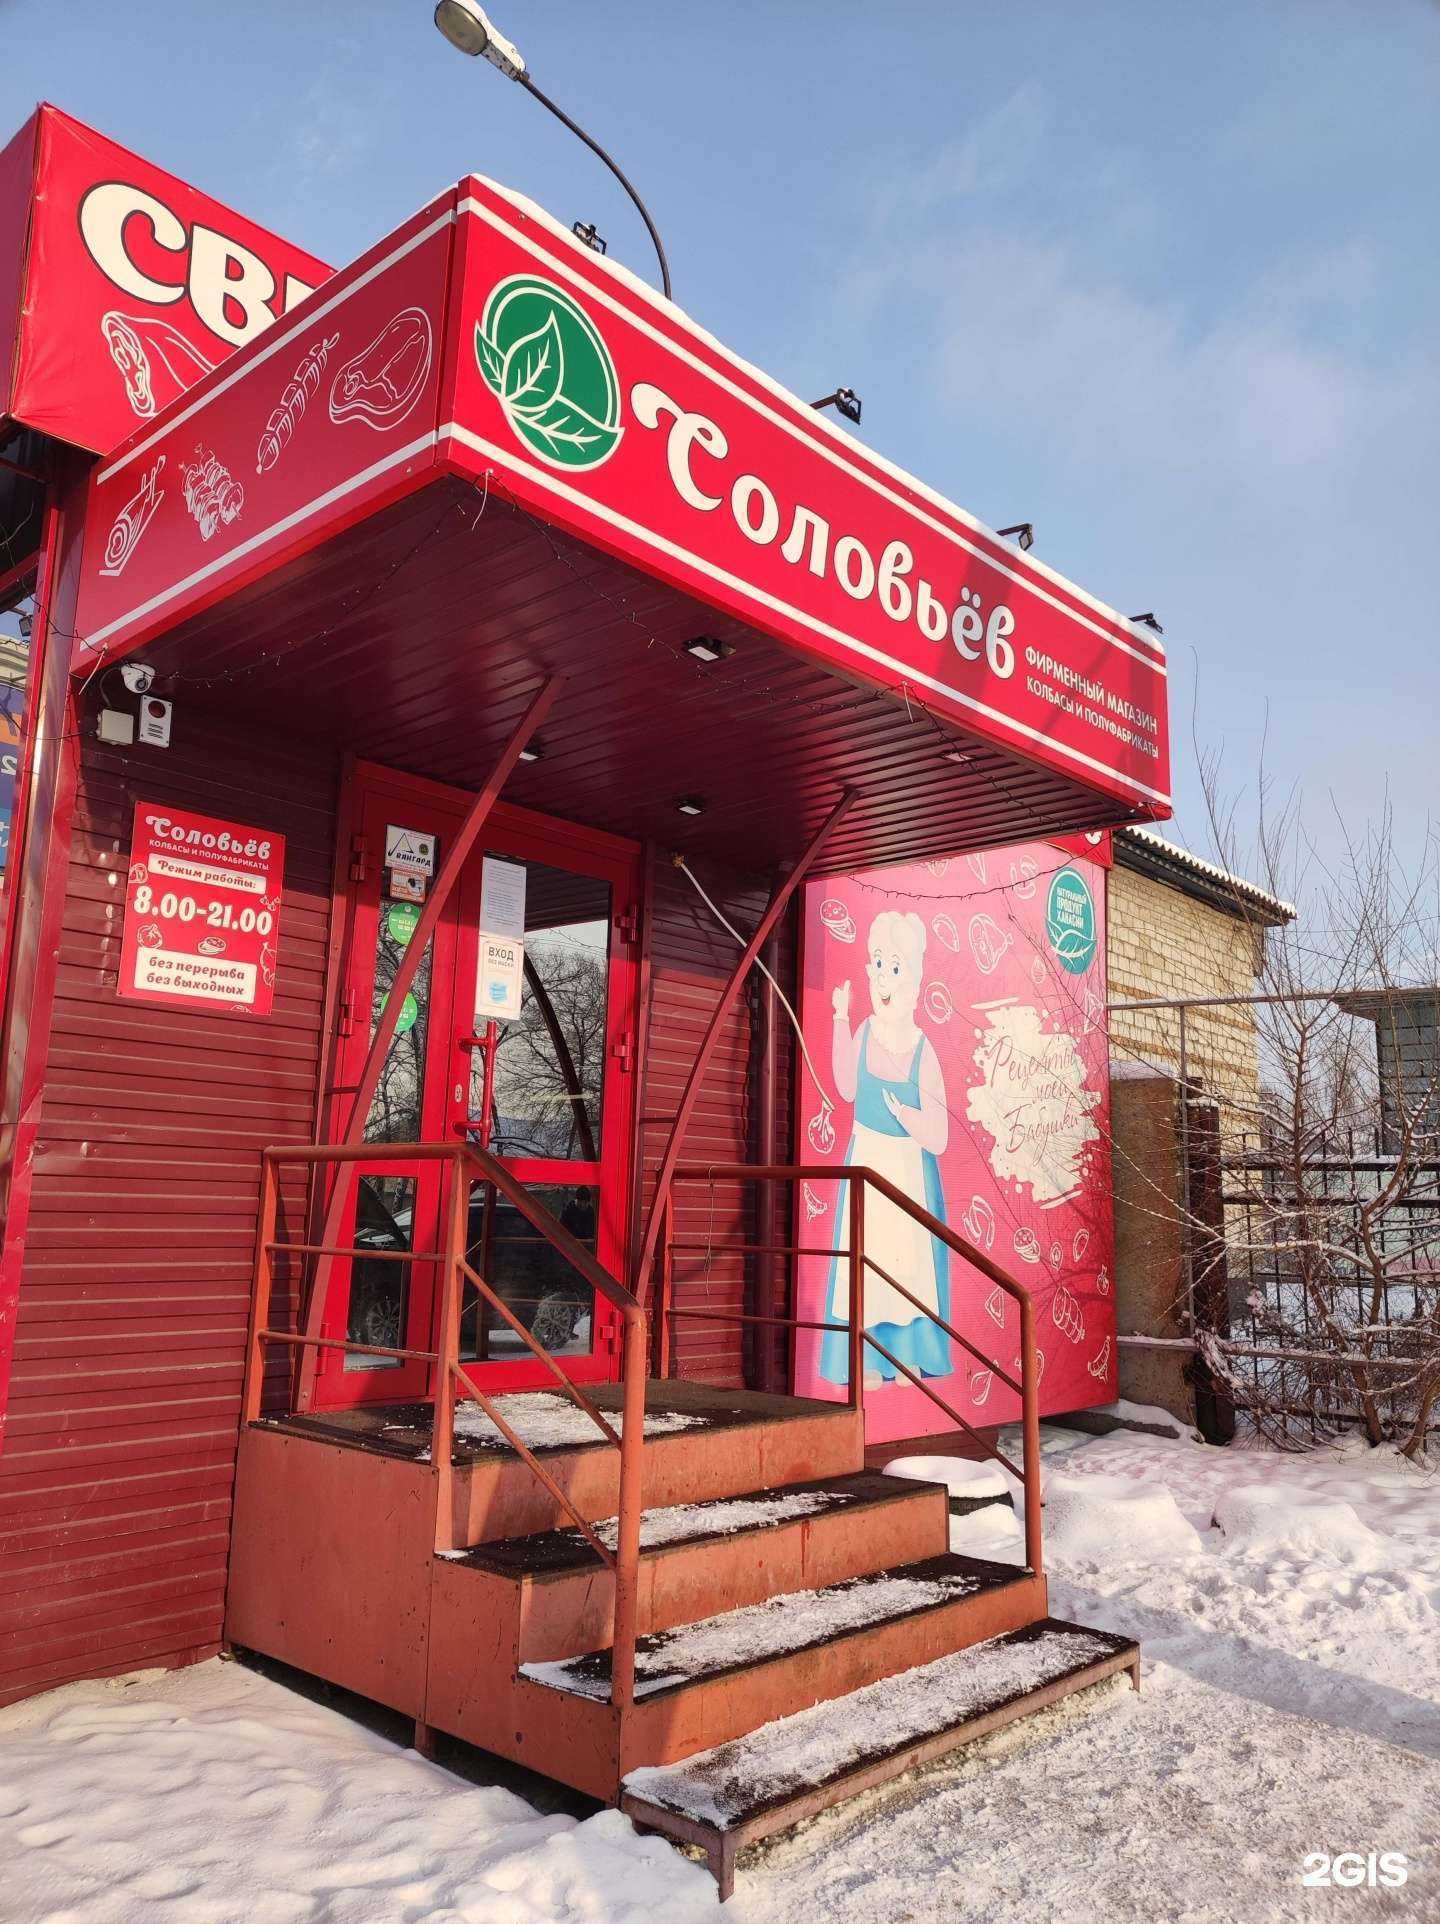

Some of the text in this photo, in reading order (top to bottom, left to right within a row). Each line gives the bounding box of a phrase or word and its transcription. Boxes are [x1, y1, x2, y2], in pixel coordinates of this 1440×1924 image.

[631, 381, 1016, 680] Соловьёв
[1025, 646, 1158, 735] ФИРМЕННЫЙ МАГАЗИН
[1027, 676, 1159, 759] КОЛБАСЫ И ПОЛУФАБРИКАТЫ
[145, 815, 271, 860] Соловьёв
[149, 839, 269, 871] КОЛБАСЫ И ПОЛУФАБРИКАТЫ
[158, 859, 256, 889] Режим работы:
[134, 885, 272, 935] 8.00-21.00
[149, 956, 245, 980] без перерыва
[488, 947, 514, 961] ВХОД
[146, 972, 244, 995] без выходных
